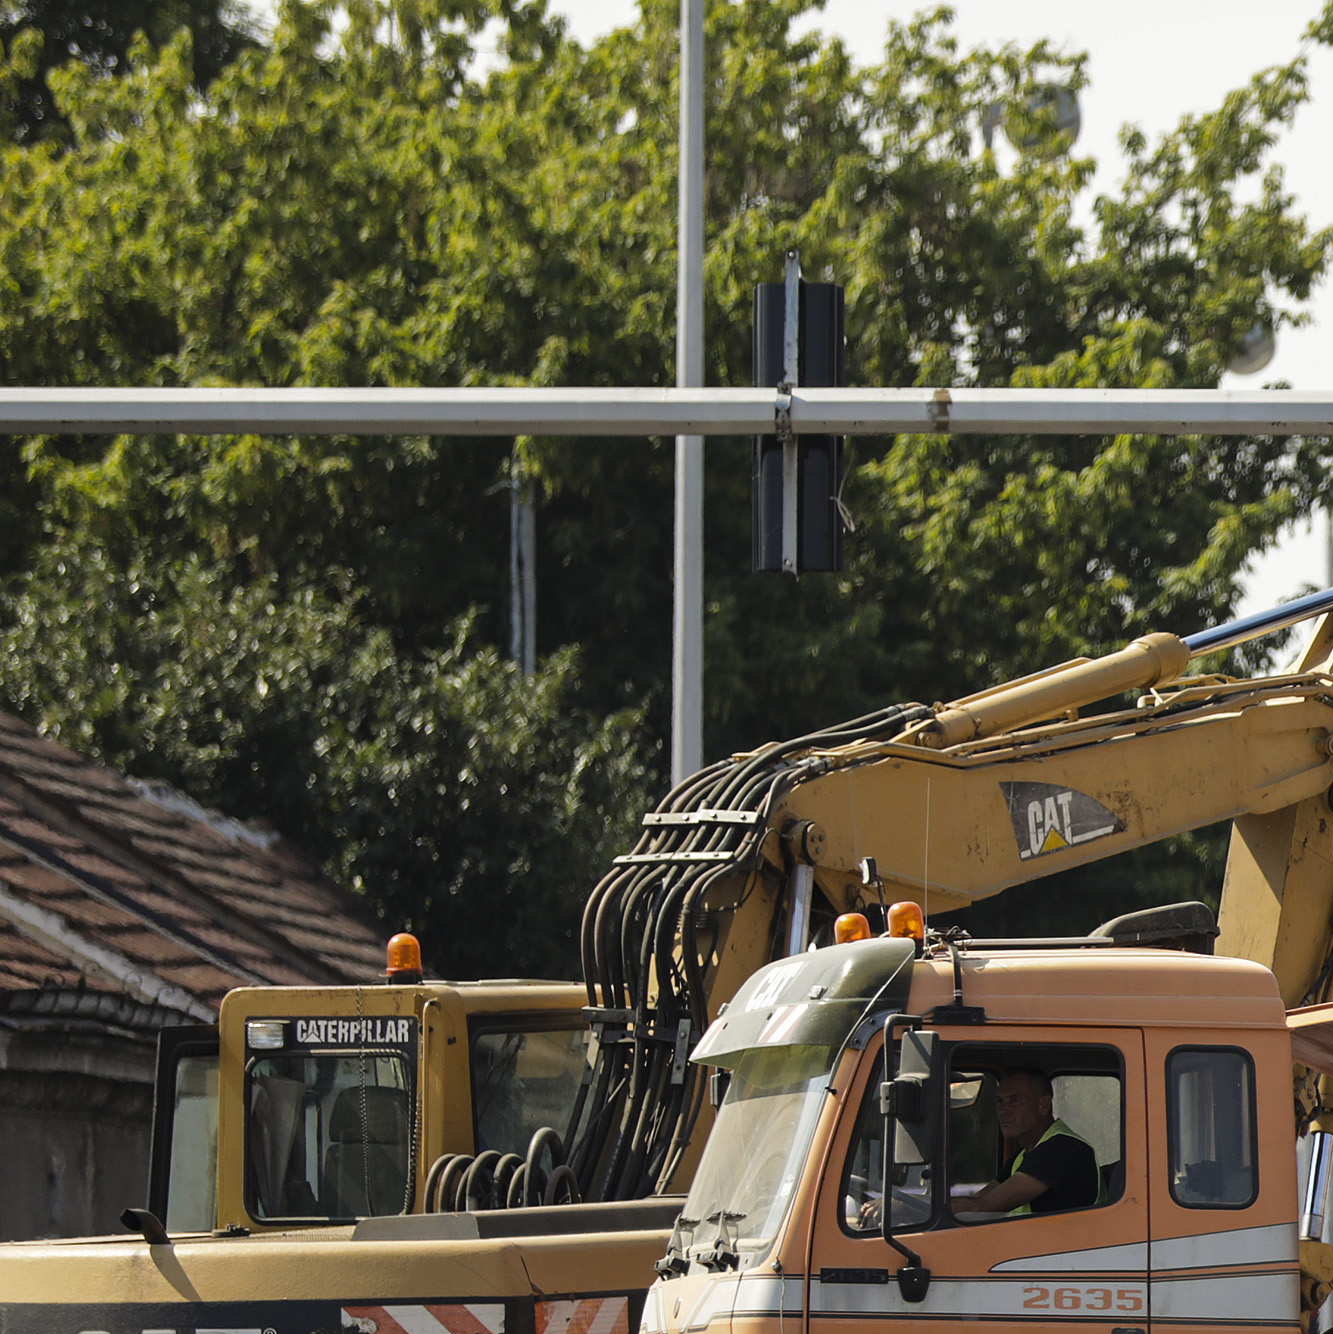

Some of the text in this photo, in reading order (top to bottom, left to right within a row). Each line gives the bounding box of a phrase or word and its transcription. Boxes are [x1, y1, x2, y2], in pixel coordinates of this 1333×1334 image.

[1027, 791, 1073, 855] CAT
[296, 1019, 409, 1043] CATERPILLAR
[1023, 1287, 1143, 1311] 2635
